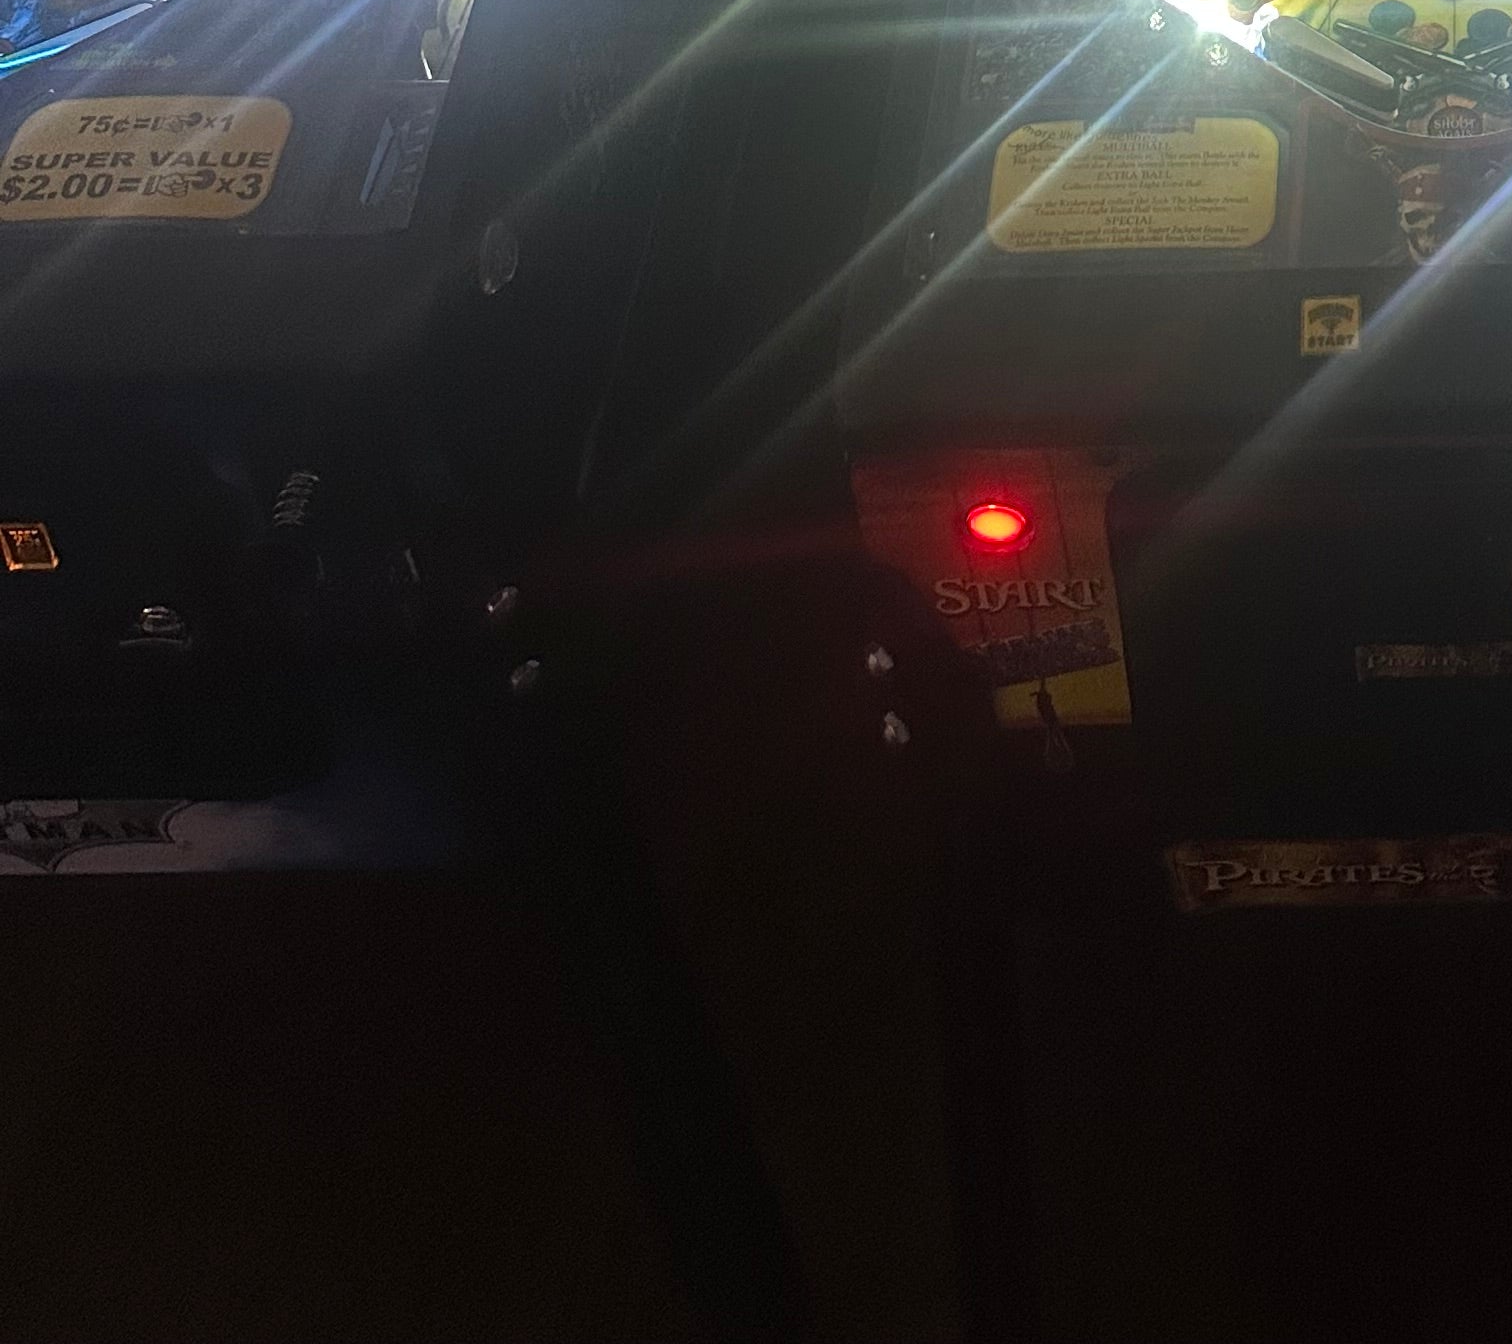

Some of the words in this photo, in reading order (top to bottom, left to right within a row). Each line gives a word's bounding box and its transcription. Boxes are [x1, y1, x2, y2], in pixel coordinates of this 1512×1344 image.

[1433, 118, 1476, 129] SHOOT
[9, 151, 136, 171] SUPER
[150, 150, 274, 168] VALUE
[1307, 335, 1354, 348] START
[935, 578, 1103, 616] START
[1184, 858, 1425, 892] PIRATES
